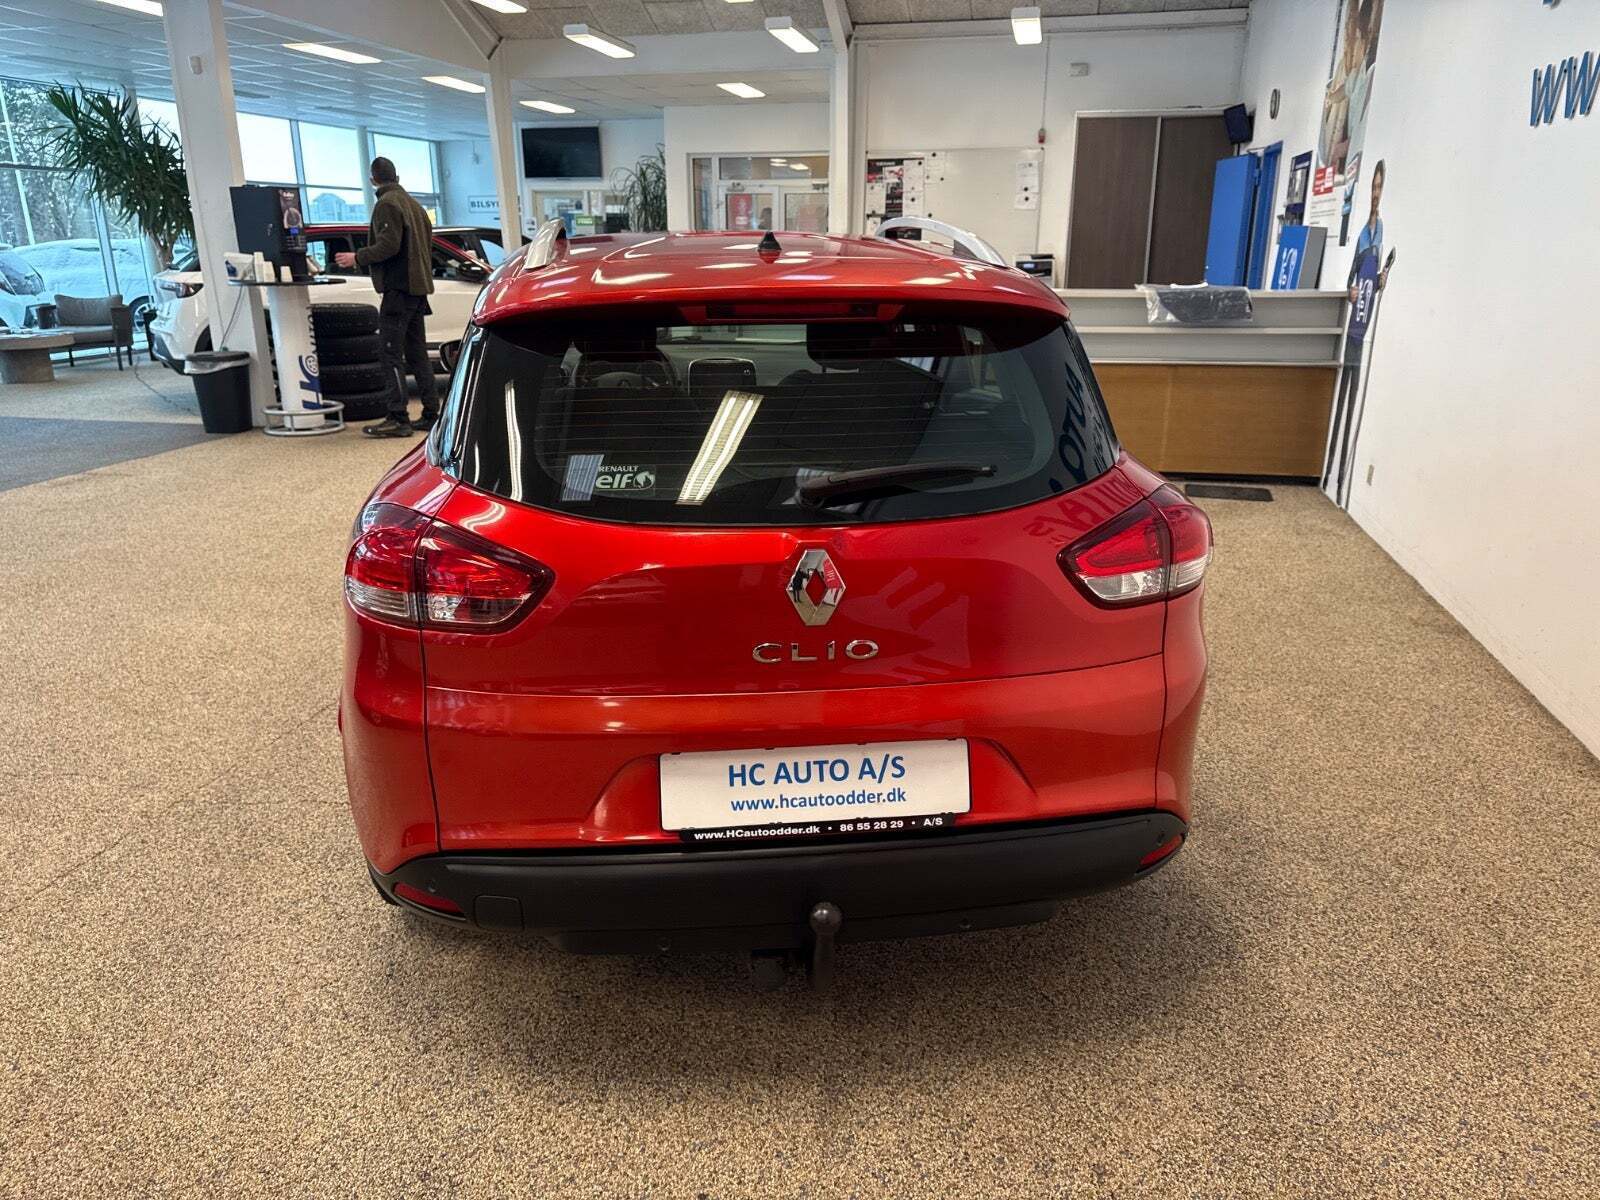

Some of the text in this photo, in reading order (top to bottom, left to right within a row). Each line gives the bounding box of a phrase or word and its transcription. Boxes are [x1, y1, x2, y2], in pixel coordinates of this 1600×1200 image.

[595, 474, 634, 488] elf
[752, 640, 879, 662] CLIO
[729, 753, 906, 787] HC AUTO A/S
[731, 787, 906, 811] www.hcautoodder.dk
[694, 817, 943, 840] www.HCautoodder.dk 86 55 28 29 A/S
